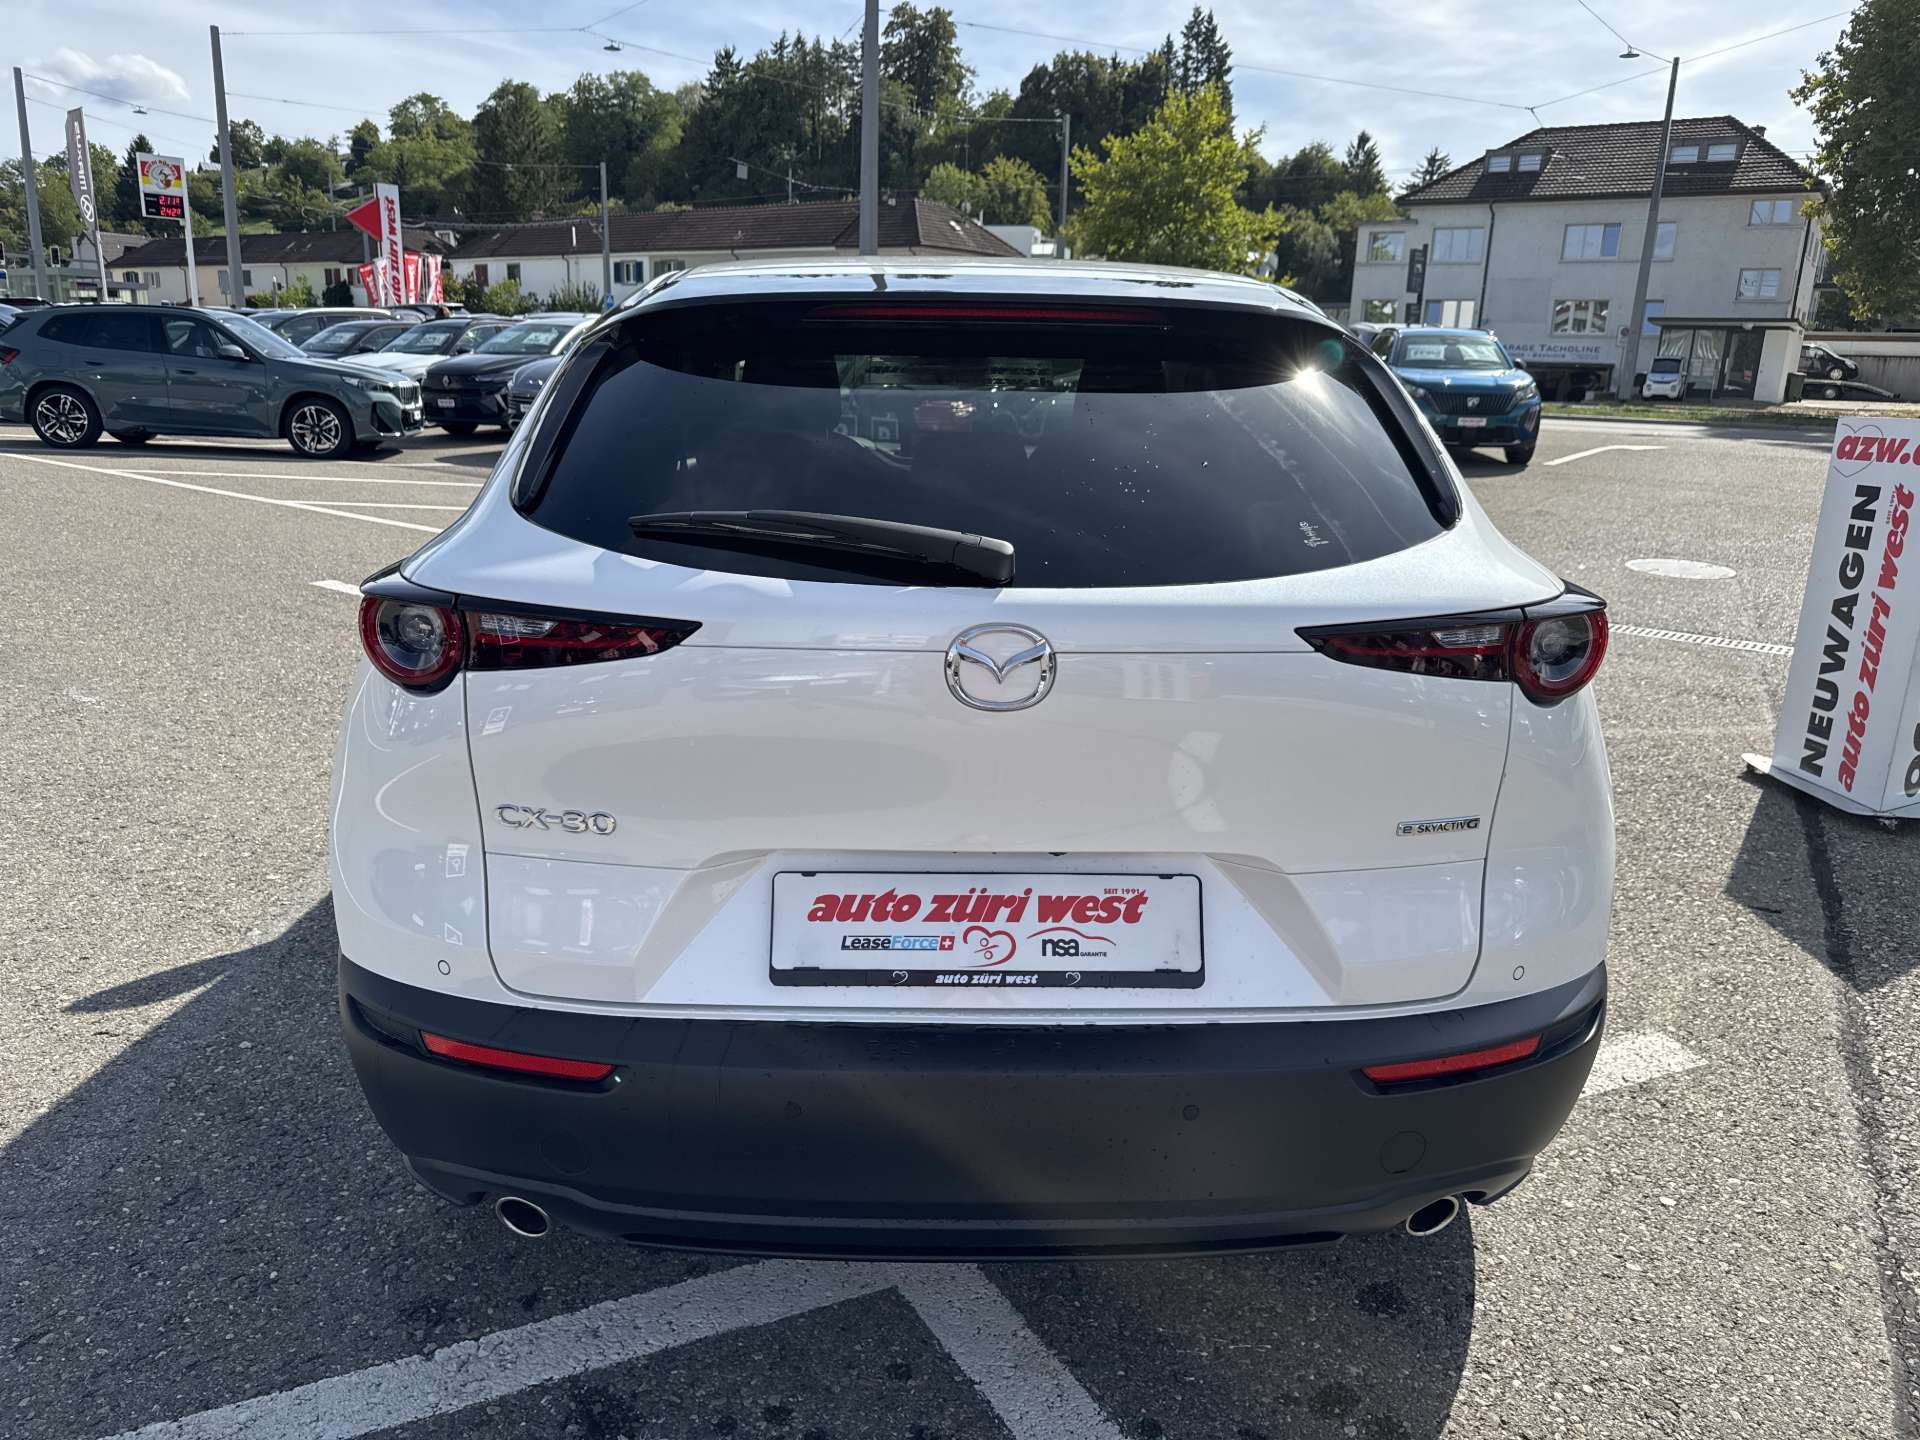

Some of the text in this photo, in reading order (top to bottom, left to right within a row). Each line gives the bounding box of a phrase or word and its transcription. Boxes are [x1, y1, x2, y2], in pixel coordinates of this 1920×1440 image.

[384, 195, 397, 236] west
[1504, 343, 1601, 354] ARAGE TACHOLINE
[1799, 484, 1882, 778] NEUWAGEN
[1837, 482, 1915, 793] auto züri west
[496, 804, 617, 836] CX-30
[1121, 888, 1140, 896] 1991
[807, 887, 1149, 924] auto züri west
[841, 935, 940, 950] LeaseForce
[1041, 938, 1080, 958] nsa
[935, 972, 1039, 985] auto züri west
